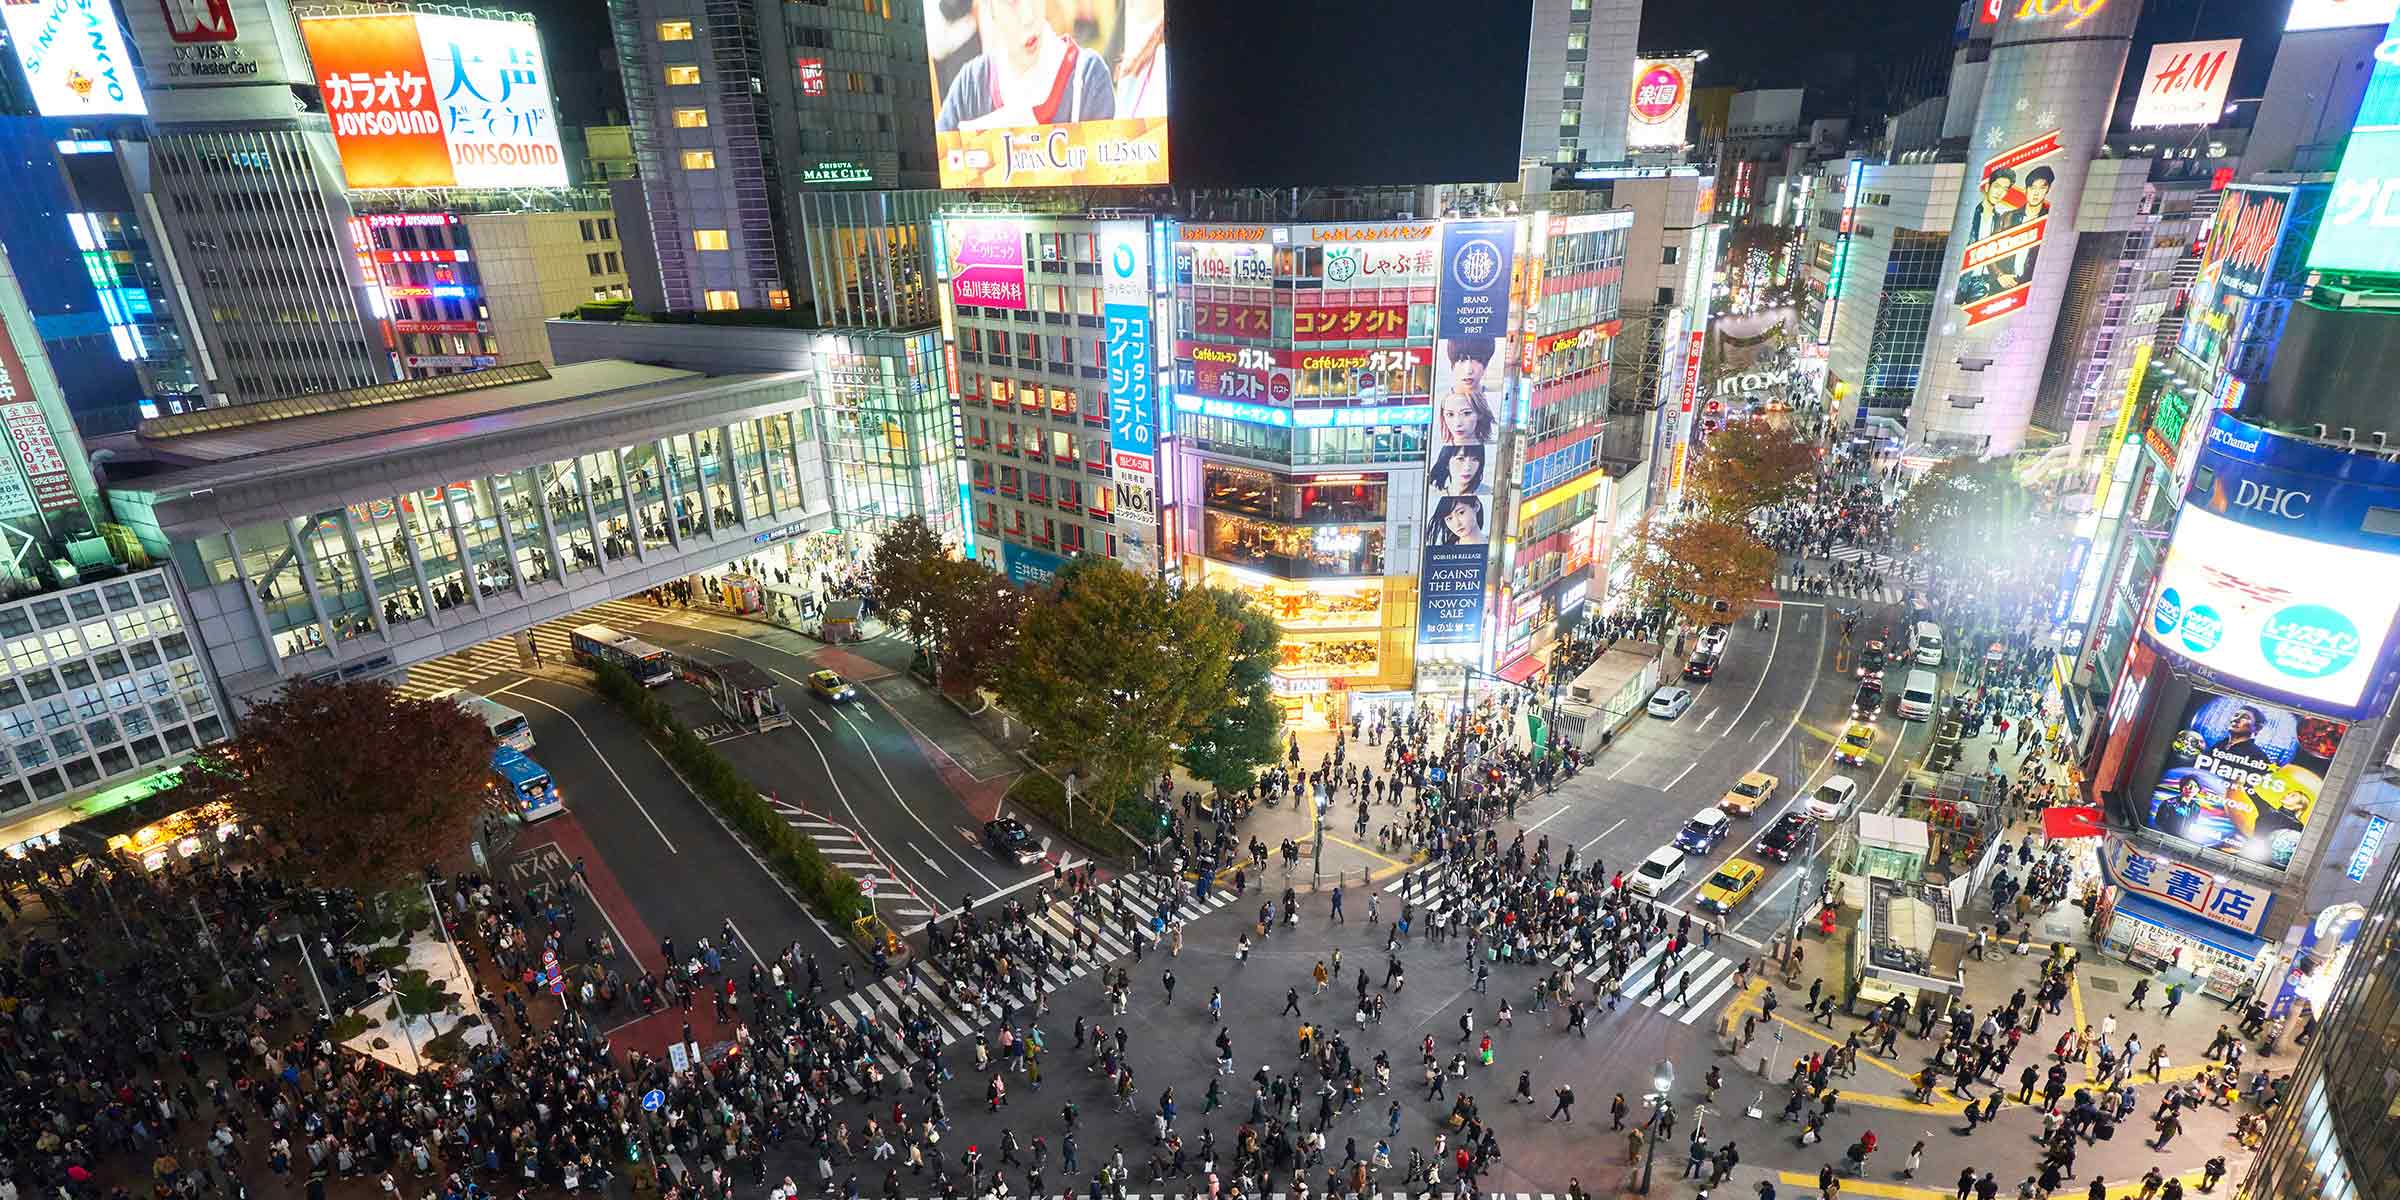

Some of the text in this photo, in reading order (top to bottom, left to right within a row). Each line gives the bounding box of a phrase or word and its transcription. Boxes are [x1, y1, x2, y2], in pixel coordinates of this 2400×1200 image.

[199, 46, 227, 59] VISA
[191, 61, 258, 75] MasterCard
[2151, 50, 2227, 94] H&M
[326, 71, 427, 109] カラオケ
[1638, 83, 1677, 106] 楽園
[337, 111, 439, 136] JOYSOUND
[455, 143, 558, 166] JOYSOUND
[803, 168, 871, 181] MARK CITY
[818, 161, 853, 169] SHIBUYA
[369, 214, 446, 227] カラオケ JOYSOUND
[1181, 226, 1264, 241] しゃぶしゃぶバイキング
[1312, 225, 1434, 241] しゃぶしゃぶバイキング
[962, 280, 1022, 300] 品川美容外科
[1463, 296, 1489, 304] BRAND
[1197, 308, 1270, 330] プライス
[1458, 316, 1490, 324] SOCIETY
[1475, 306, 1493, 314] IDOL
[1295, 311, 1404, 333] コンタクト
[1464, 326, 1483, 334] FIRST
[1238, 349, 1276, 370] ガスト
[1368, 350, 1421, 372] ガスト
[1109, 317, 1133, 441] アイシティ
[1131, 318, 1149, 444] コンタクトの
[1220, 371, 1265, 399] ガスト
[2223, 433, 2258, 453] Channel
[1116, 482, 1154, 514] No.1
[2234, 479, 2311, 519] DHC
[1116, 508, 1155, 524] コンタクトショップ
[1432, 569, 1480, 580] AGAINST
[1428, 580, 1480, 591] THE PAIN
[1428, 598, 1477, 609] NOW ON
[1440, 609, 1464, 619] SALE
[2212, 748, 2269, 772] teamLab
[2194, 755, 2286, 794] Planets
